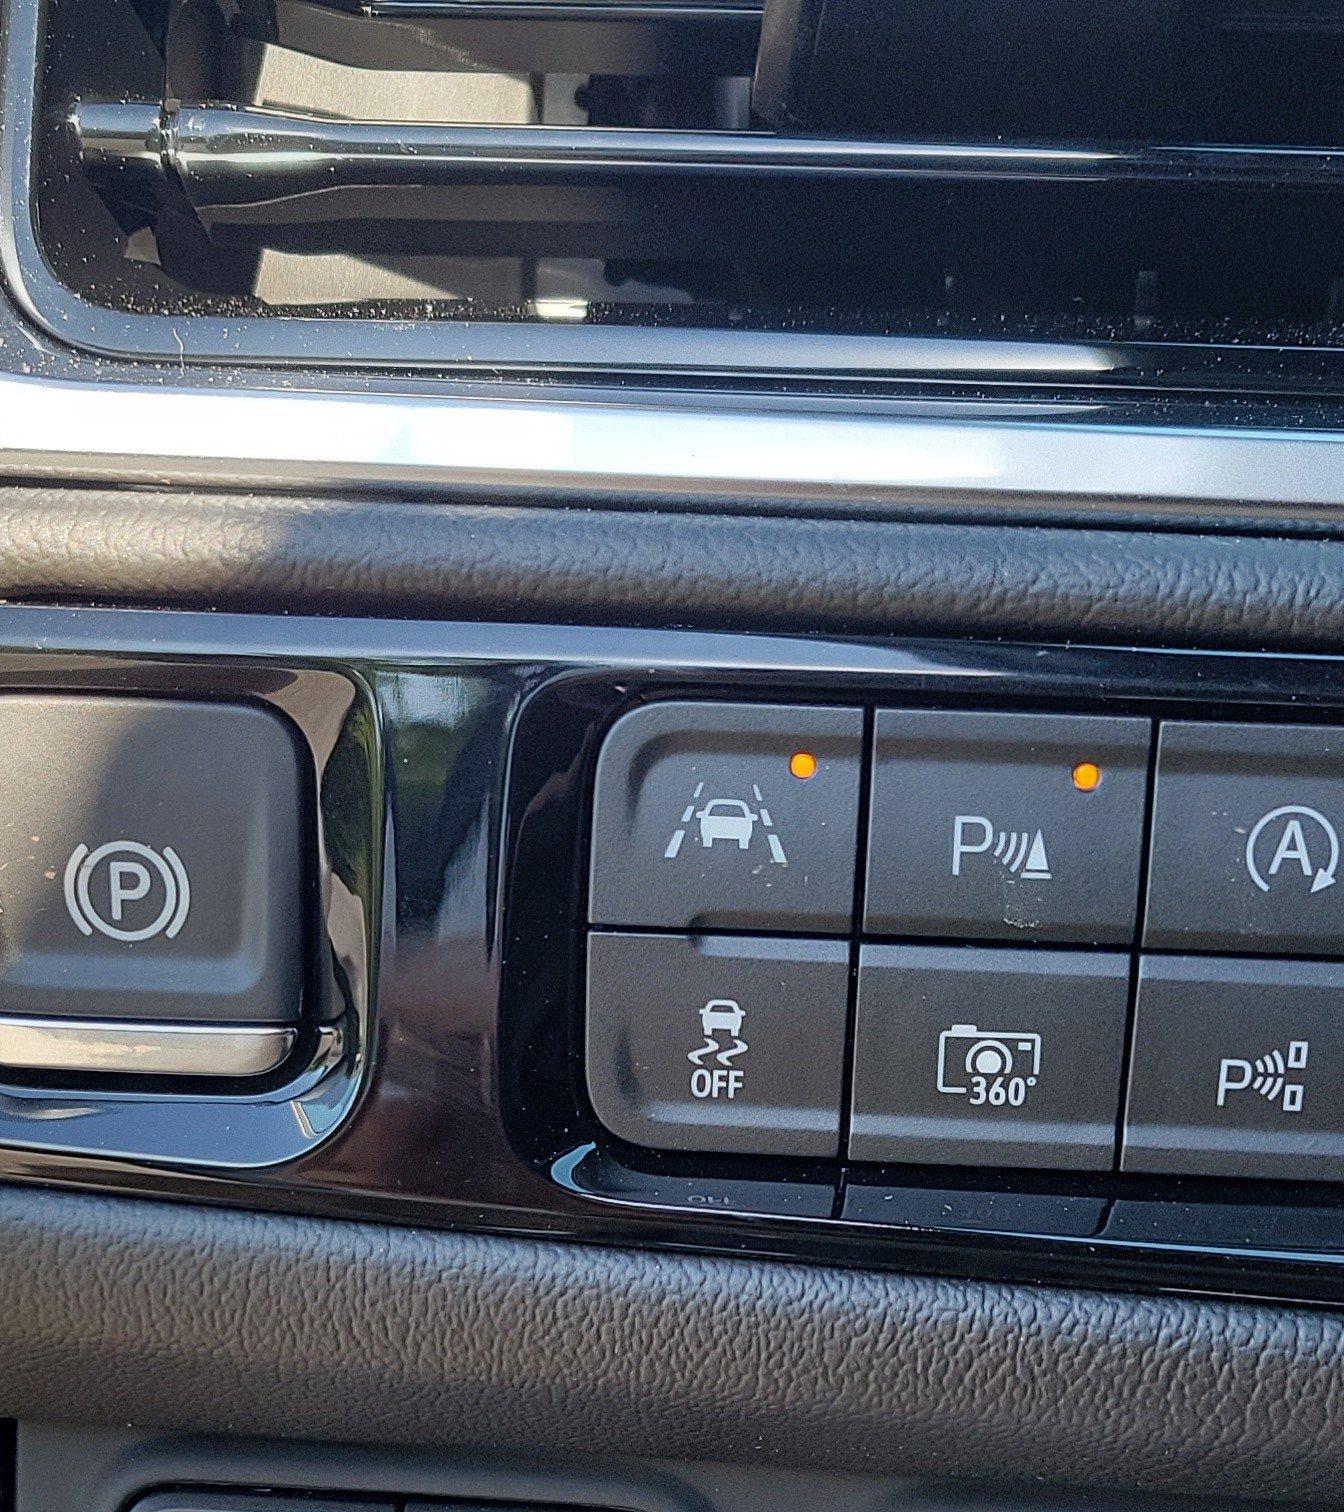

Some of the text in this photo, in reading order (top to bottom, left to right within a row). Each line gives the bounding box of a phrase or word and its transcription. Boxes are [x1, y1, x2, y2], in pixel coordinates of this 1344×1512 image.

[952, 815, 995, 876] P
[1268, 818, 1313, 876] A
[690, 1069, 744, 1099] OFF
[1217, 1057, 1254, 1107] P
